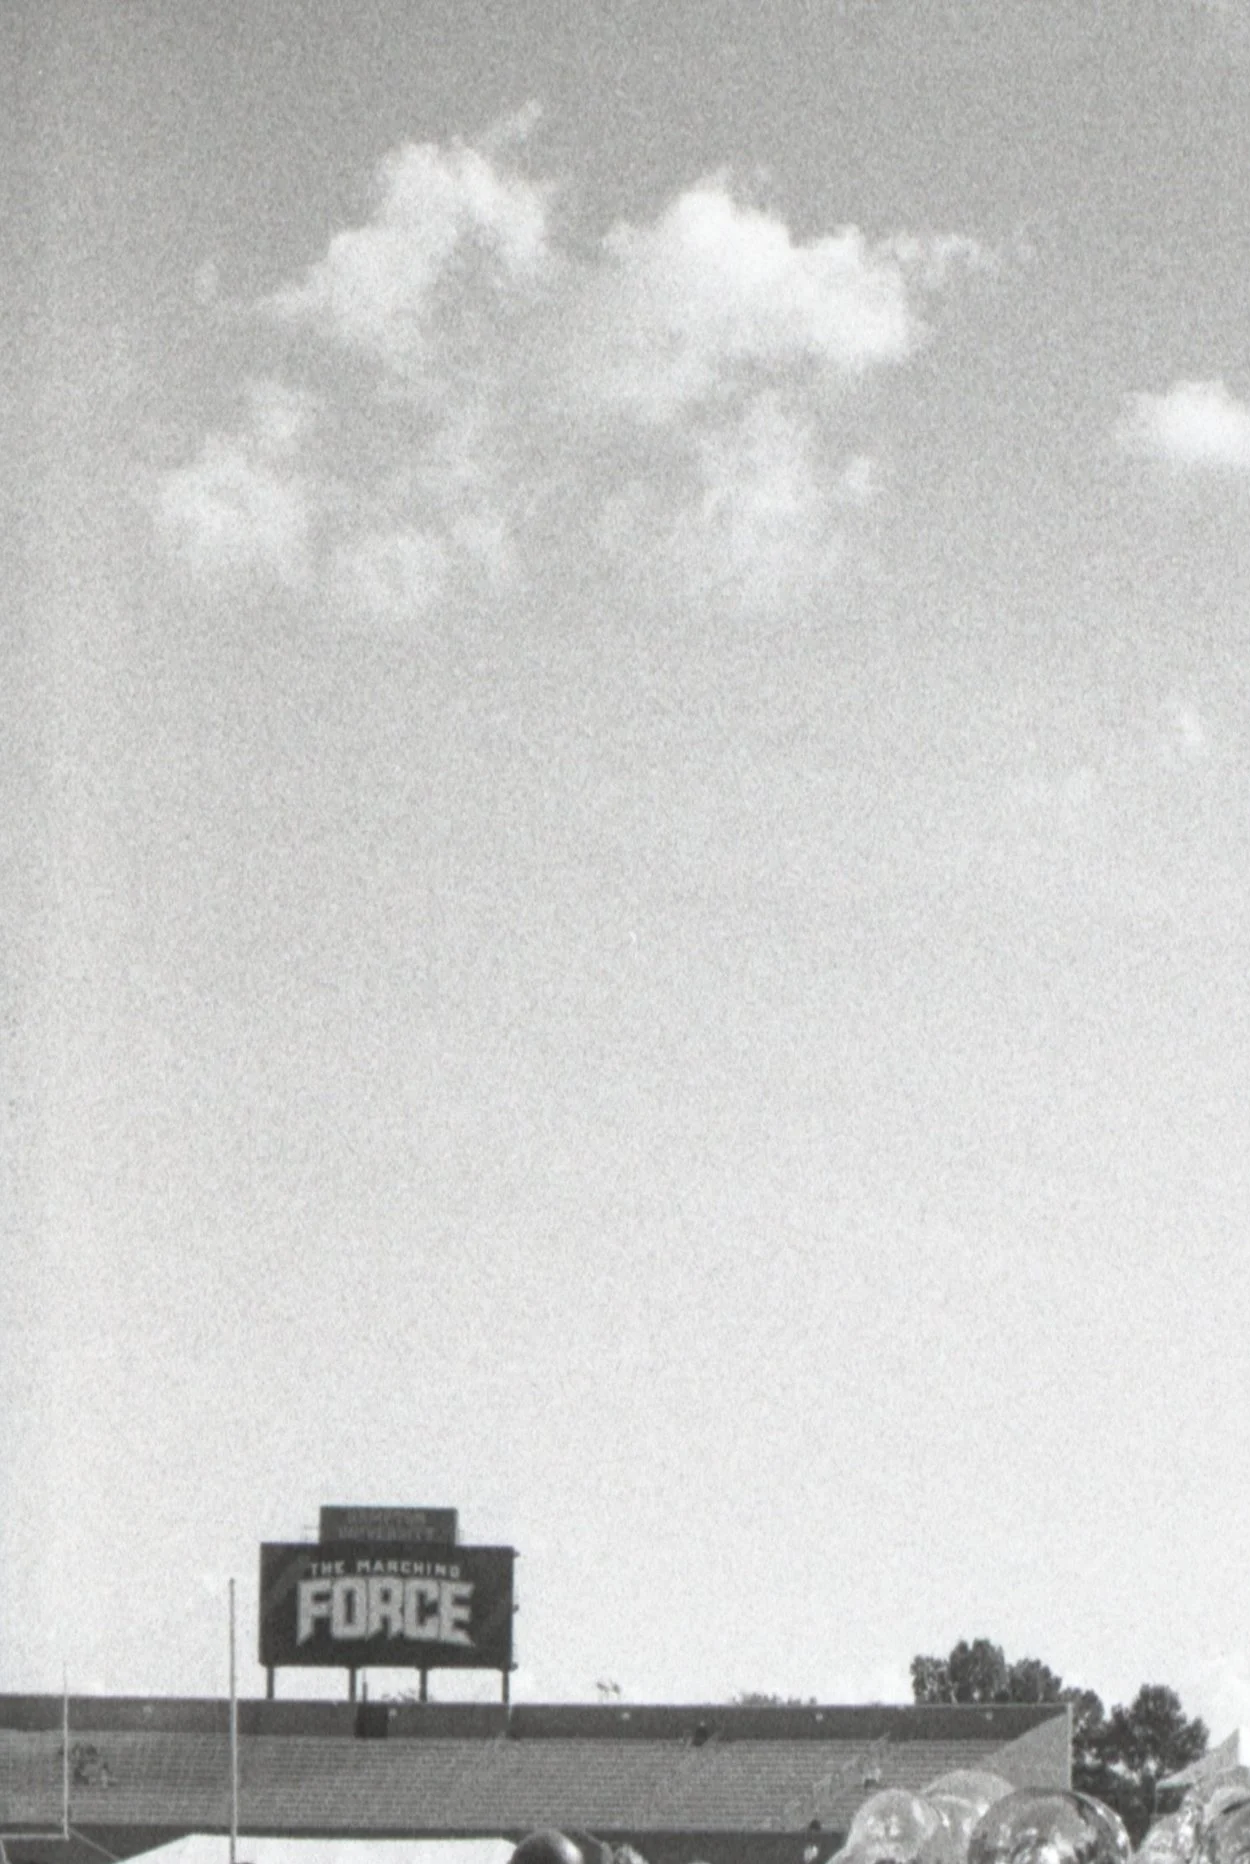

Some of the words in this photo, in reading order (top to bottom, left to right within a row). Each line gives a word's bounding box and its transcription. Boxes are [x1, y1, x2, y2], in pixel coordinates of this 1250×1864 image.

[310, 1561, 345, 1578] THE
[356, 1560, 461, 1579] MARCHING
[297, 1575, 477, 1648] FORCE
